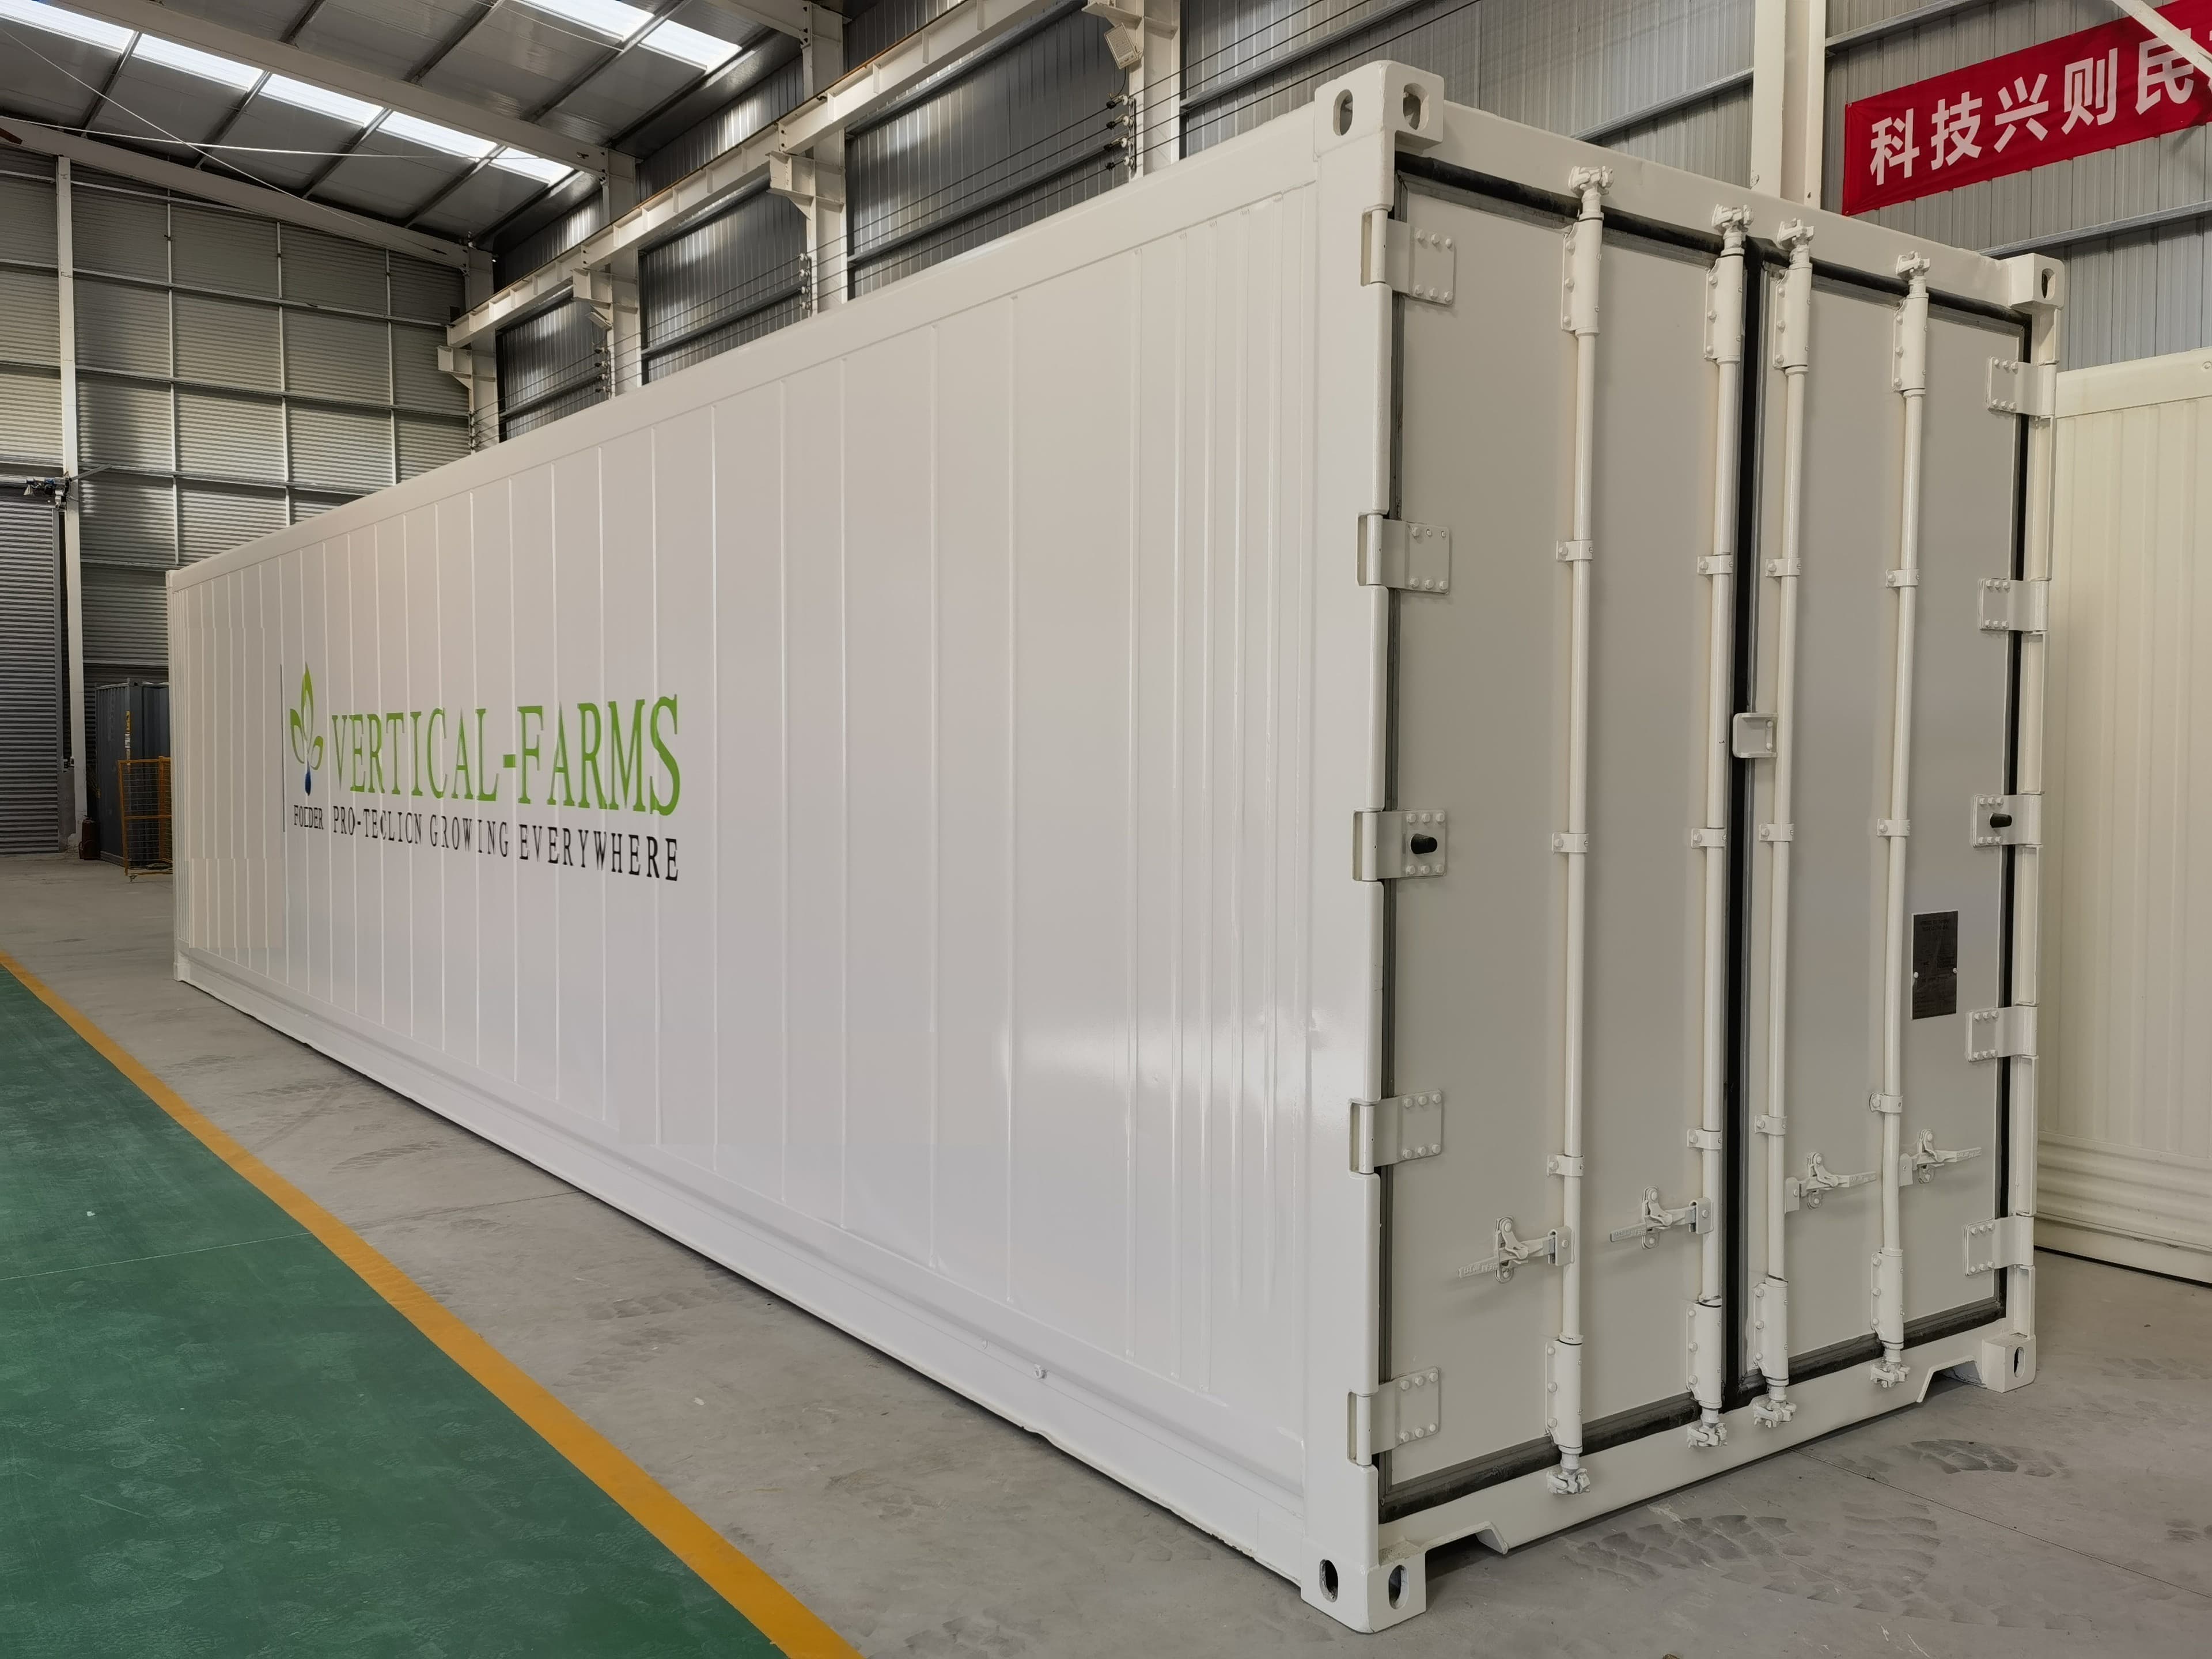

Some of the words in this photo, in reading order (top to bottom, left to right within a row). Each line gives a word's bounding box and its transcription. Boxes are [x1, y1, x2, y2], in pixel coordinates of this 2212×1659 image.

[1870, 29, 2212, 185] 科技兴则民
[332, 694, 681, 816] VERTICAL-FARMS
[430, 814, 509, 858] GROWING
[518, 824, 679, 881] EVERYWHERE
